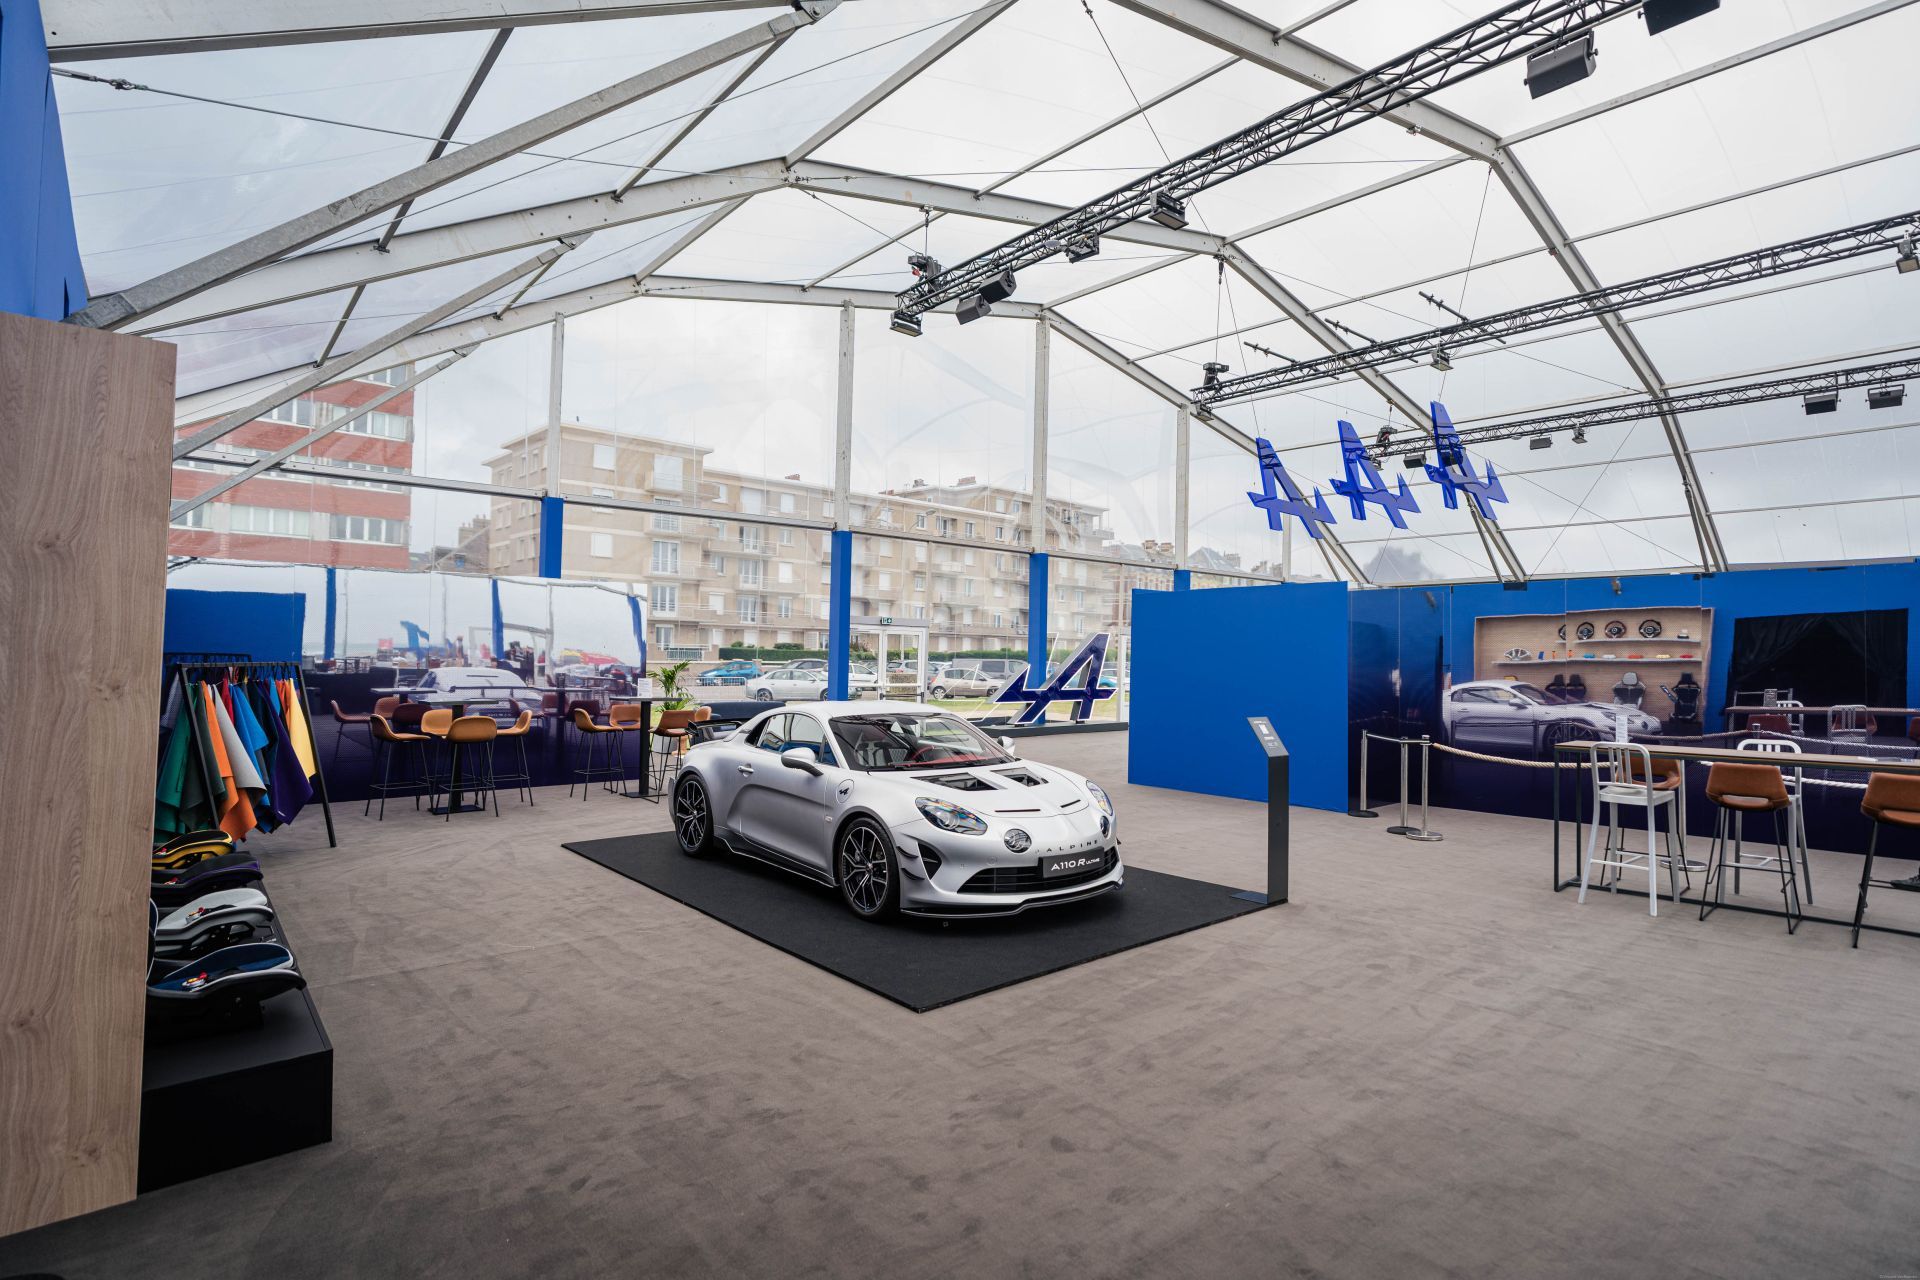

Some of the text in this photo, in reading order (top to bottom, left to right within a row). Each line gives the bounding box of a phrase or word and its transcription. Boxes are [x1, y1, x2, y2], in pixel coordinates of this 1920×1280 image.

[1046, 839, 1098, 853] ALPINE
[1051, 860, 1077, 871] A110
[1077, 858, 1086, 867] R
